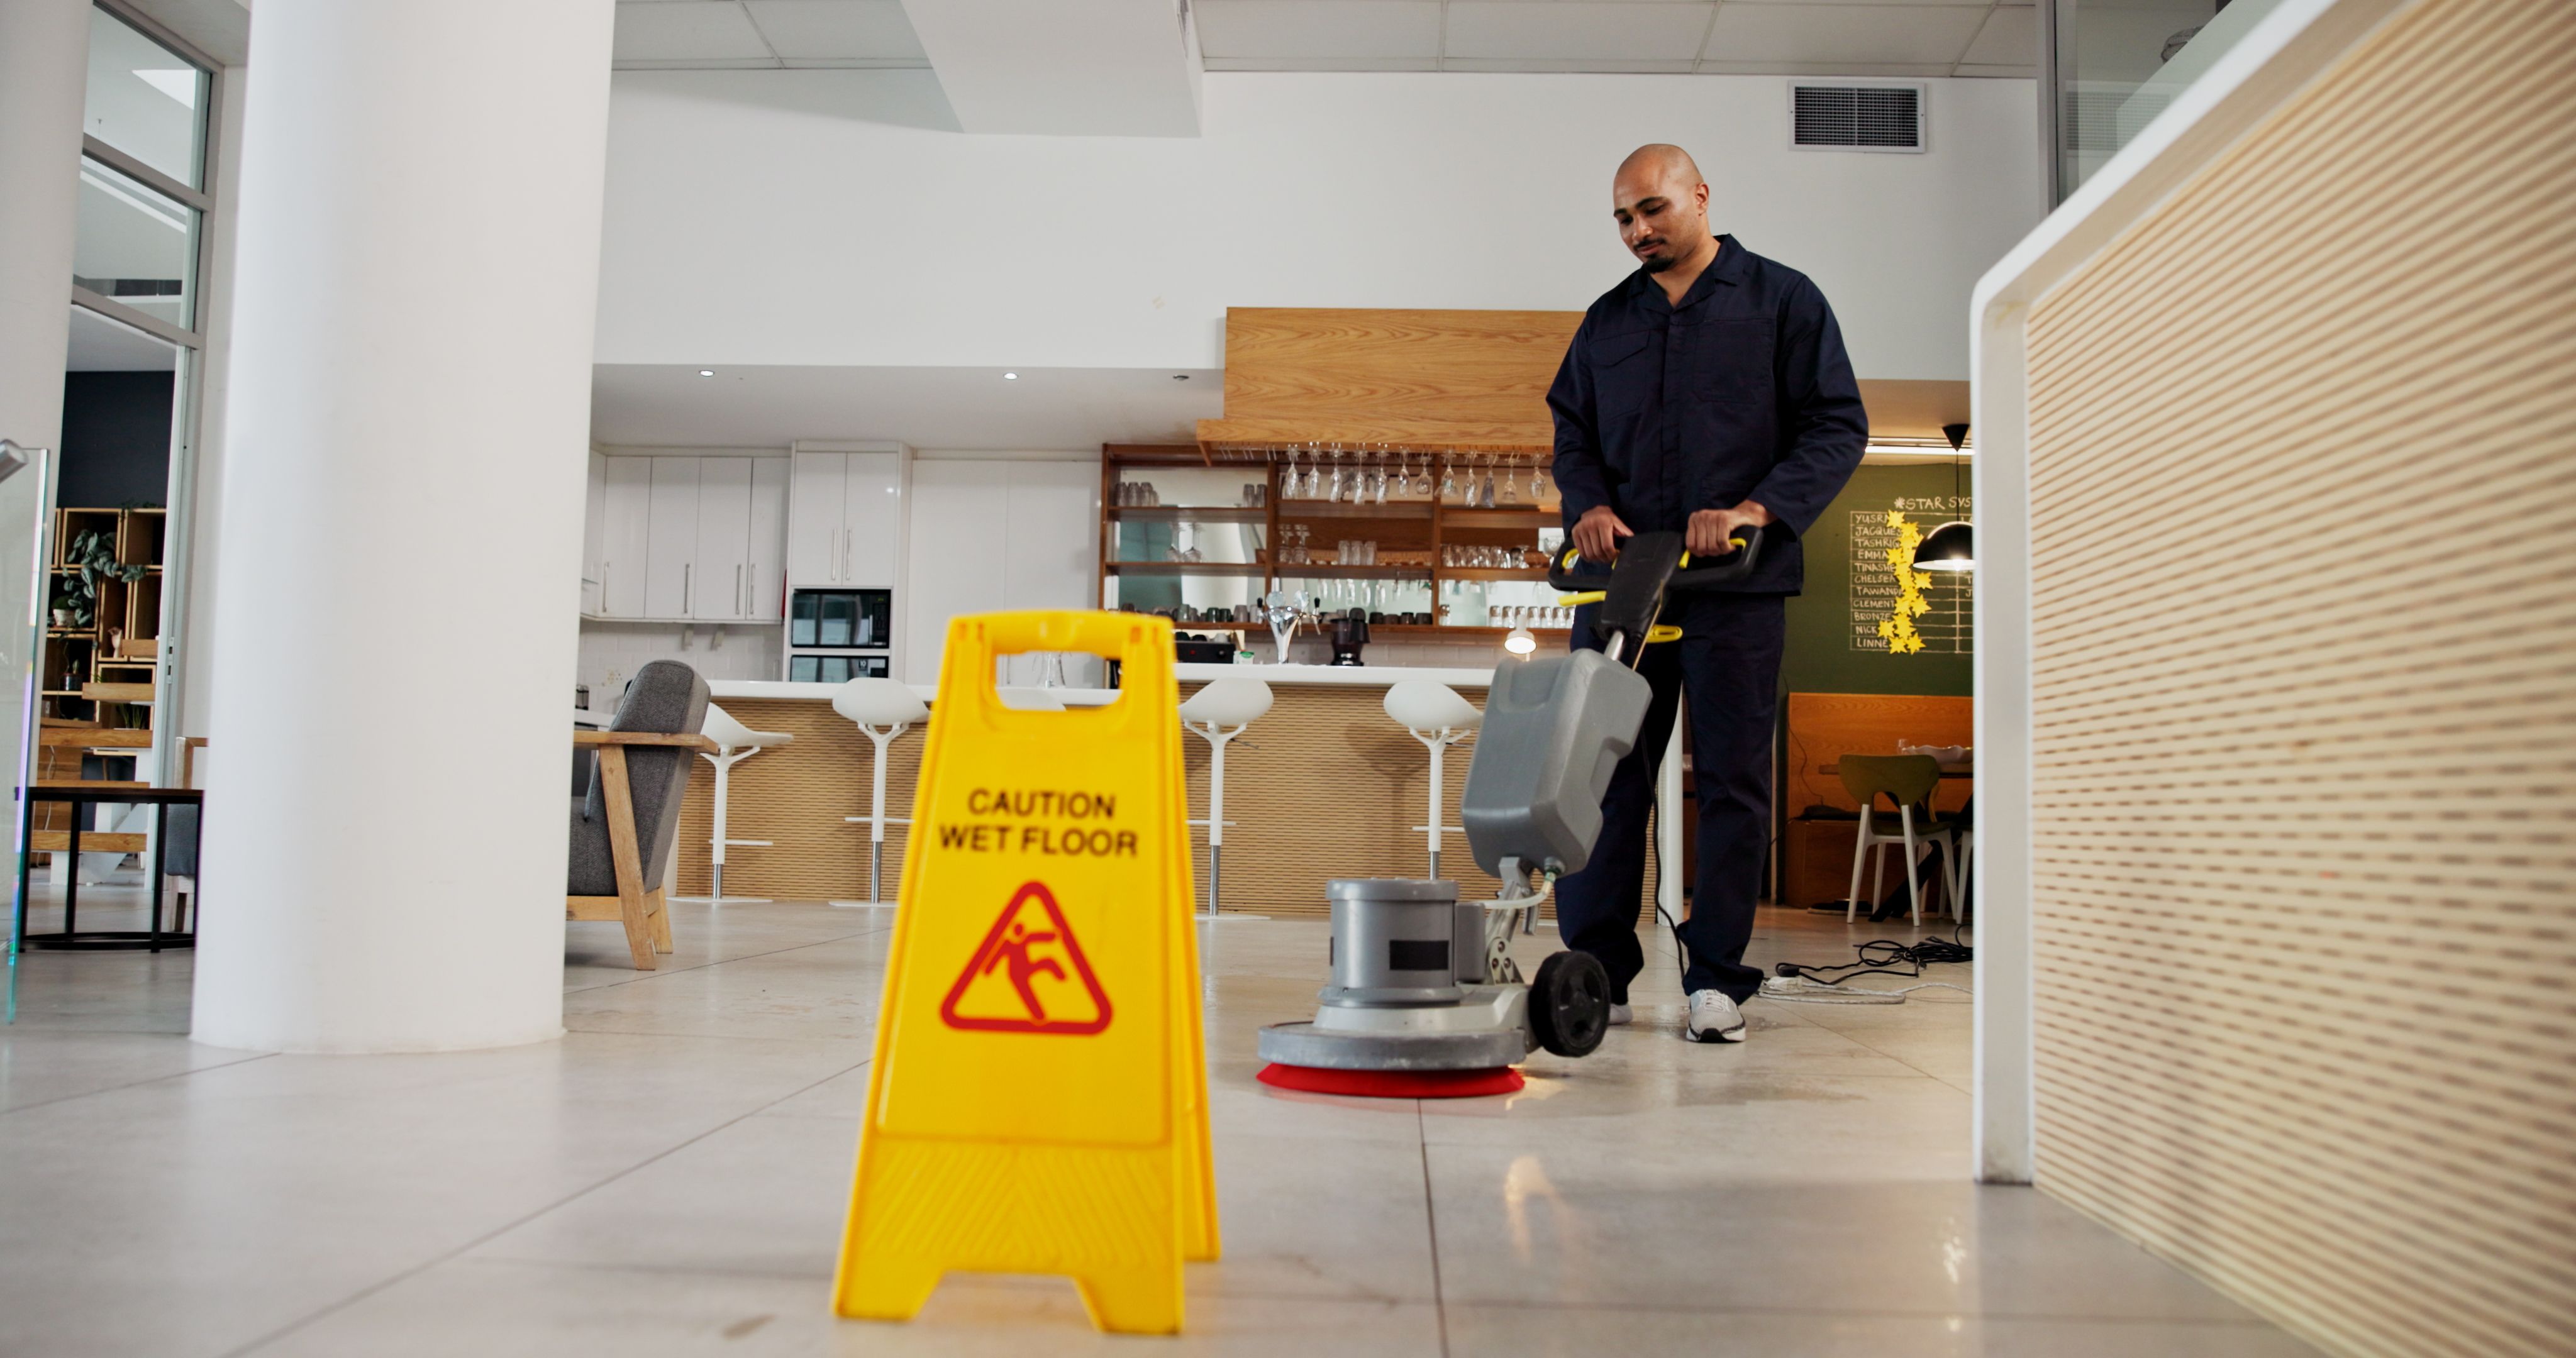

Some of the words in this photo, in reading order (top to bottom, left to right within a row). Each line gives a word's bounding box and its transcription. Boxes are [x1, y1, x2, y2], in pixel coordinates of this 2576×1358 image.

[1905, 496, 1946, 511] STAR
[1948, 496, 1972, 508] SYS
[1855, 526, 1902, 536] JACQUES
[1858, 549, 1889, 560] EMMA
[1854, 563, 1895, 573] TINASHE
[1854, 575, 1896, 584] CHELSEA
[1853, 599, 1894, 609] CLEMENT
[1854, 612, 1892, 622] BRONZE
[1856, 626, 1878, 635] NICK
[968, 788, 1116, 819] CAUTION
[940, 824, 1012, 852] WET
[1021, 826, 1138, 858] FLOOR
